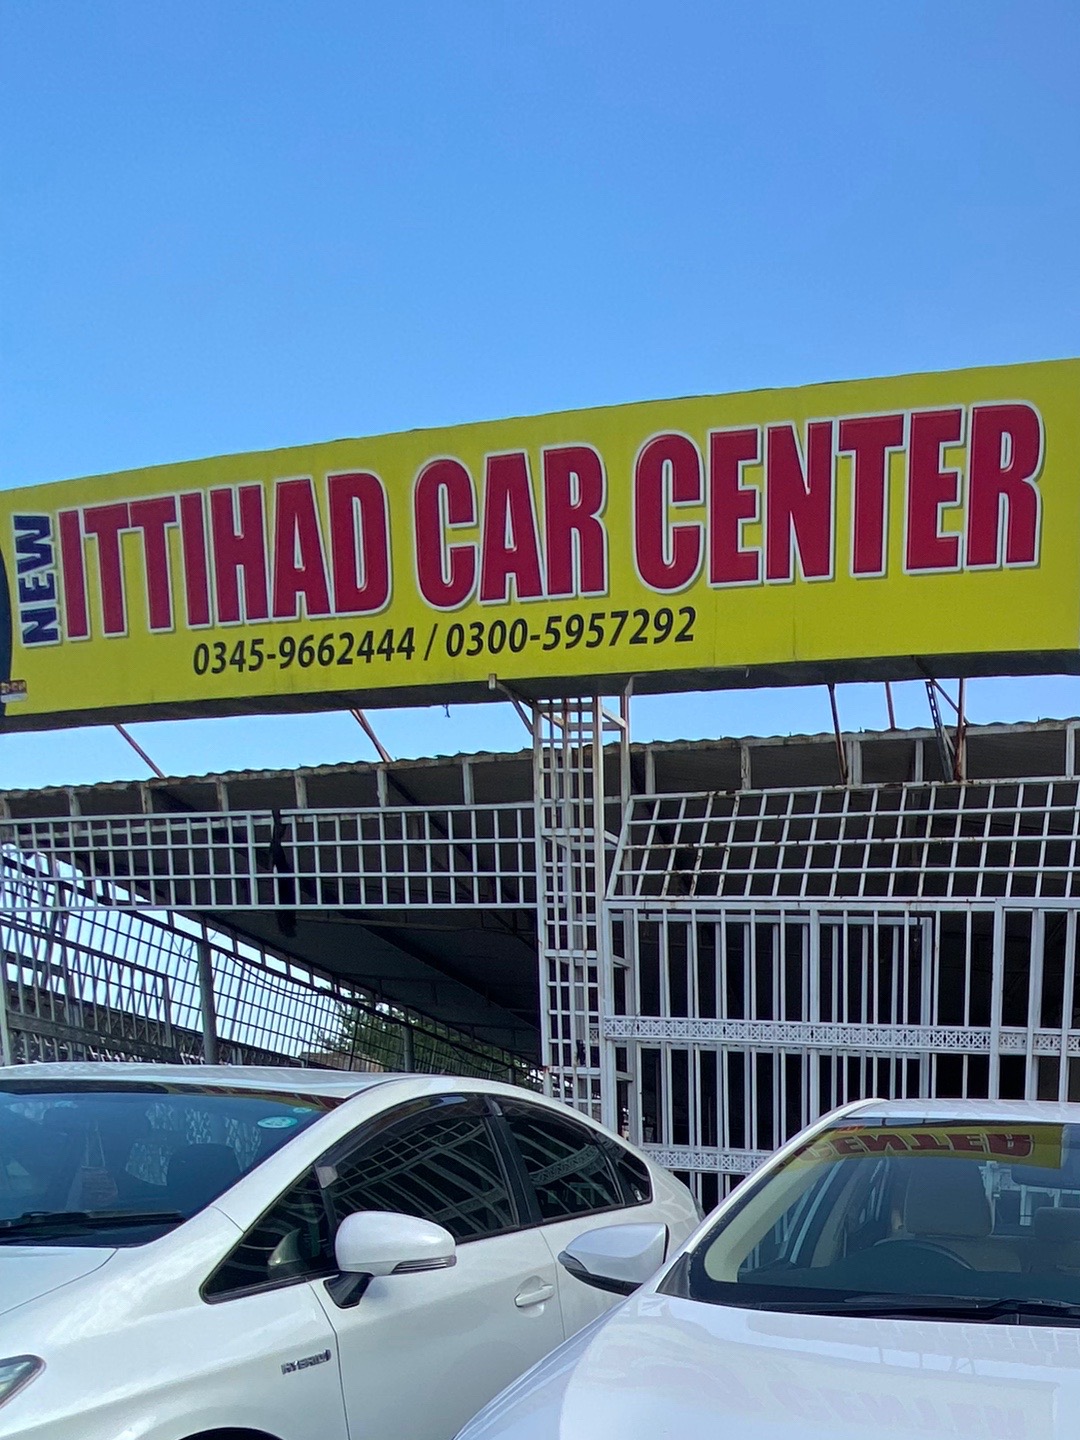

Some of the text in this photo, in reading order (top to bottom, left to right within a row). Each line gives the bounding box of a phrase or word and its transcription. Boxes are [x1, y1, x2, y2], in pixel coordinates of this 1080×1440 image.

[13, 513, 59, 646] NEW
[58, 402, 1043, 641] ITTIHAD CAR CENTER
[193, 627, 415, 676] 0345-9662444
[446, 606, 697, 658] 0300-5957292
